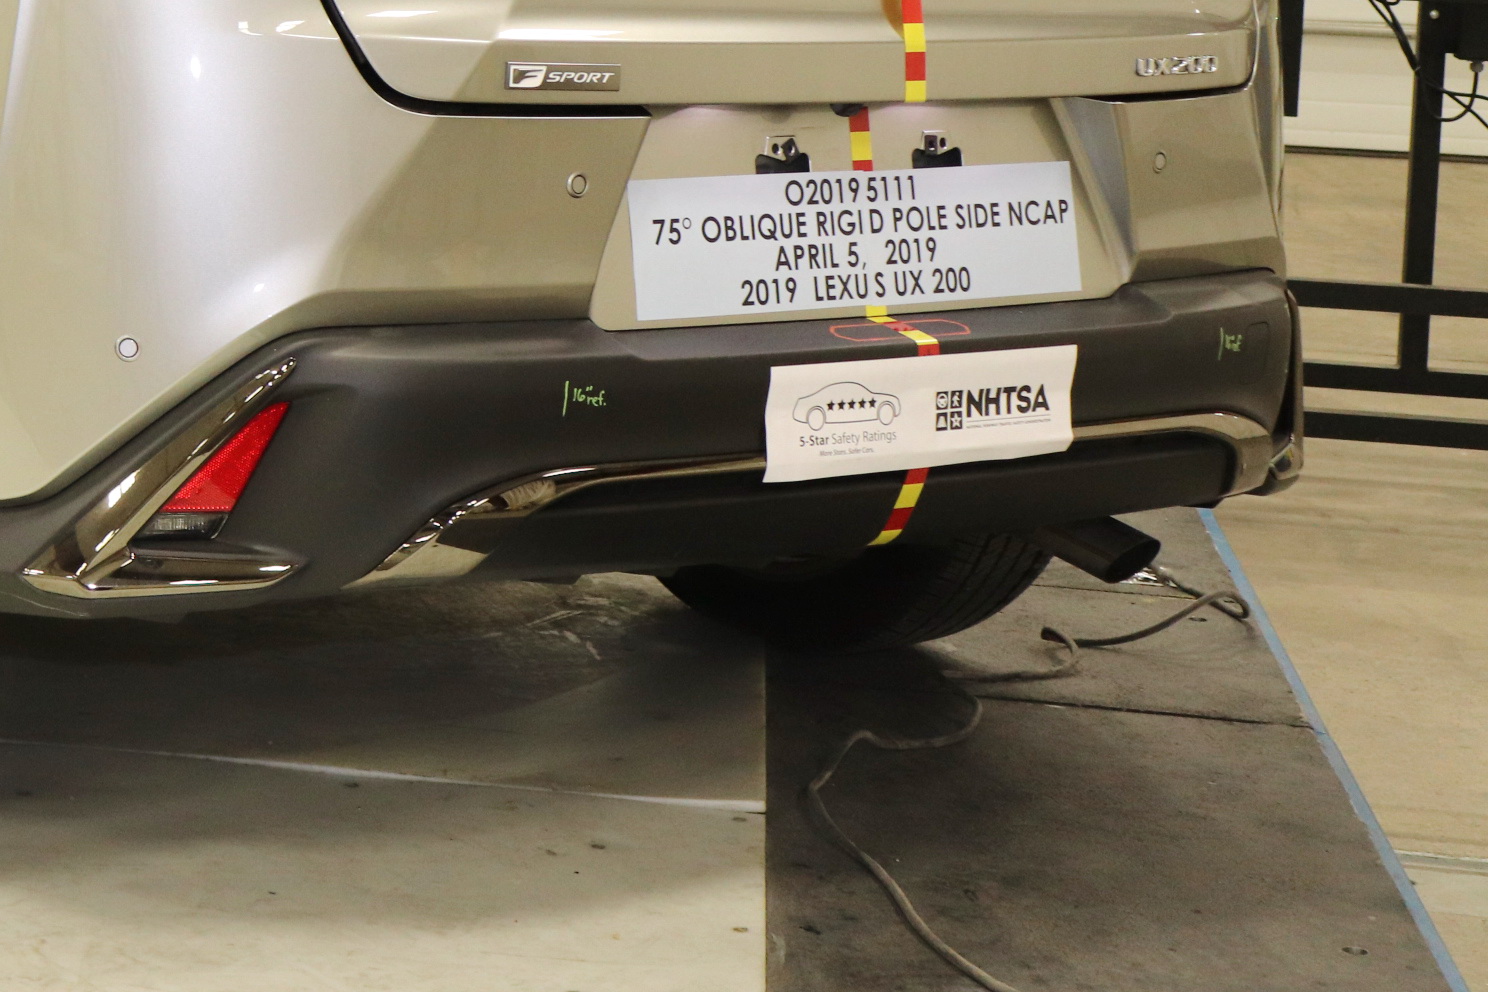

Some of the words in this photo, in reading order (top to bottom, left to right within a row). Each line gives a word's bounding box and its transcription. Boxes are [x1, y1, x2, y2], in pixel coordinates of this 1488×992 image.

[546, 71, 615, 84] SPORT
[701, 212, 808, 243] OBLIQUE
[816, 208, 884, 237] RIGID
[892, 205, 948, 233] POLE
[955, 202, 1001, 230] SIDE
[1008, 199, 1069, 227] NCAP
[775, 243, 840, 271] APRIL
[847, 242, 867, 270] 5,
[884, 236, 937, 265] 2019
[741, 277, 798, 306] 2019
[813, 271, 886, 302] LEXUS
[893, 269, 925, 296] UX
[932, 266, 971, 294] 200
[966, 383, 1050, 418] NHTSA
[799, 435, 830, 447] 5-Star
[831, 431, 860, 446] Safety
[862, 430, 897, 444] Ratings
